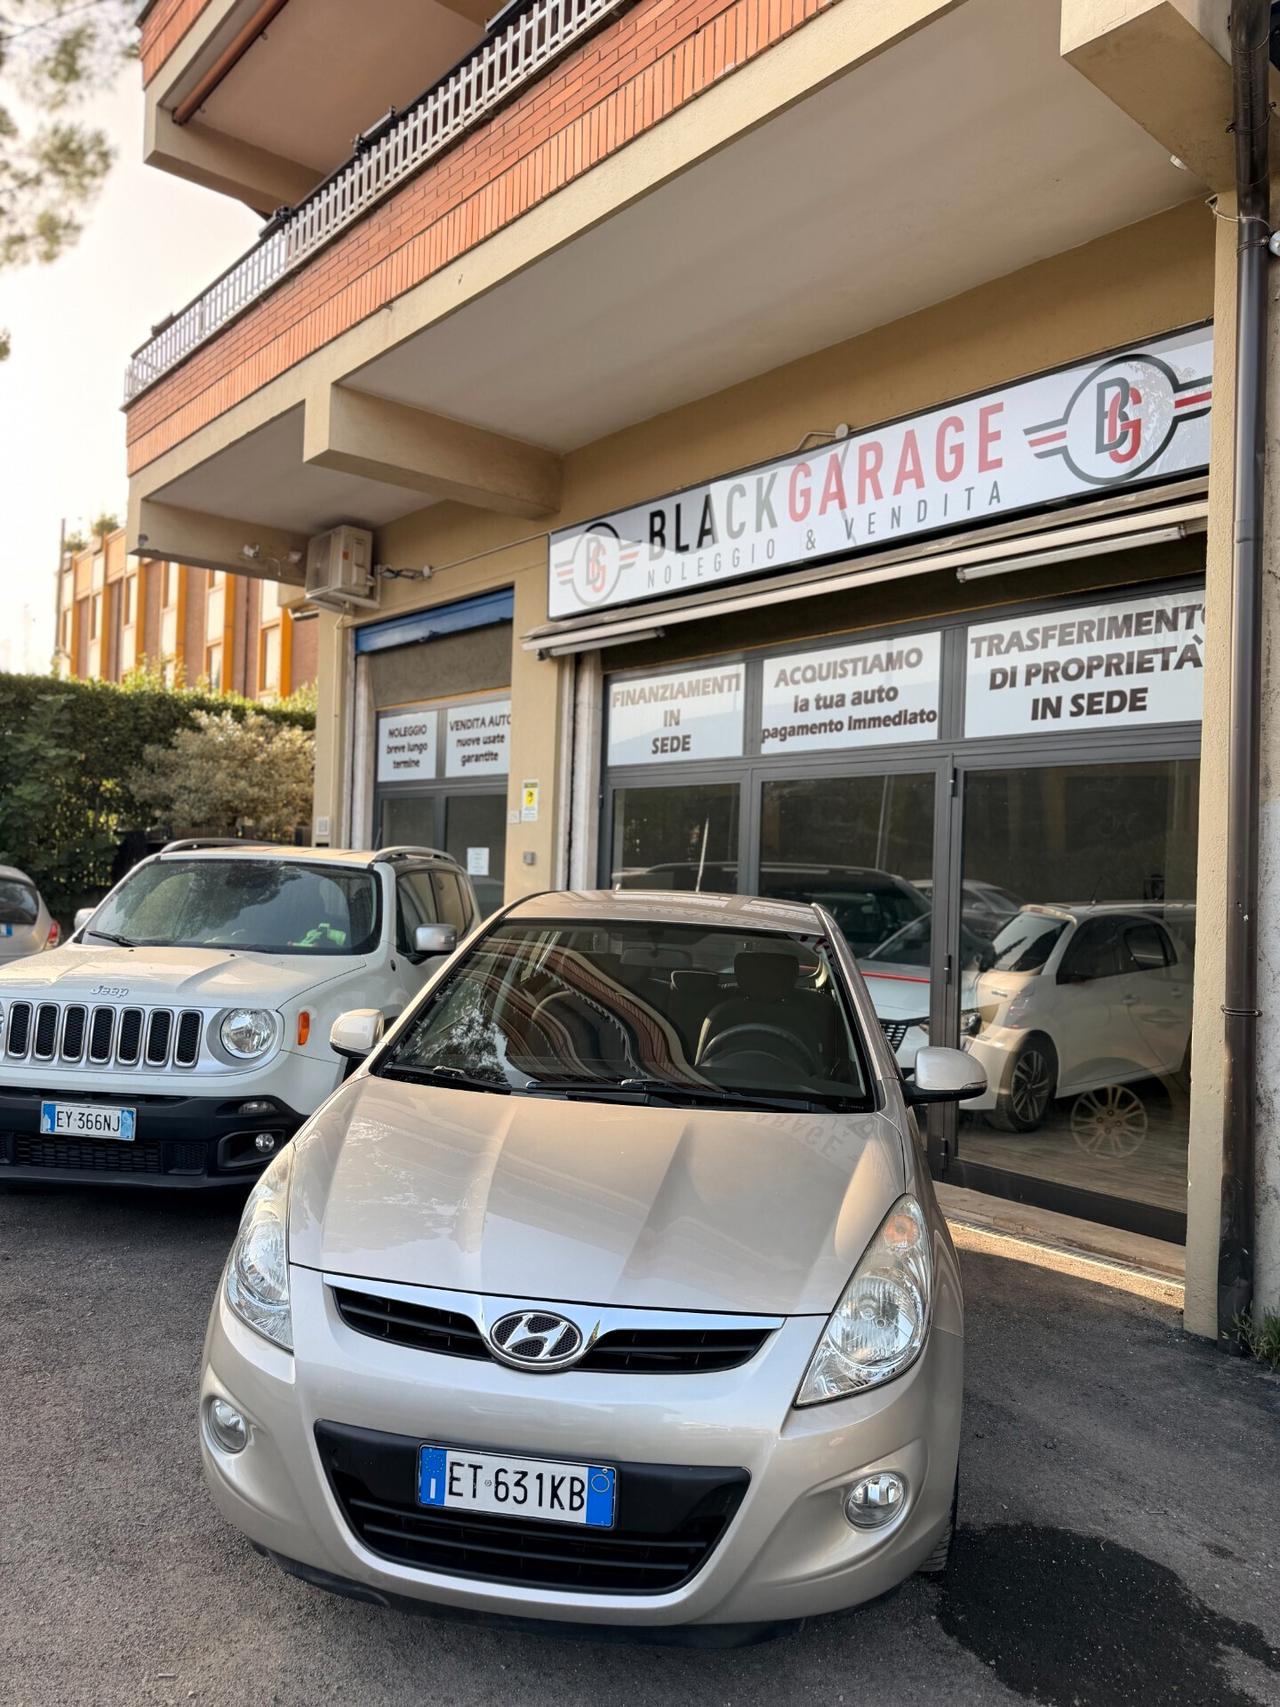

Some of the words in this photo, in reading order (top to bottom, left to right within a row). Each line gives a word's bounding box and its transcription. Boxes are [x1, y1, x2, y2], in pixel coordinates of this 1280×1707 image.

[648, 539, 775, 589] NOLEGGIO
[805, 529, 816, 551] &
[845, 480, 1001, 540] VENDITA
[970, 603, 1205, 659] TRASFERIMENT
[774, 647, 923, 688] ACQUISTIAMO
[989, 666, 1018, 690] DI
[1024, 634, 1203, 686] PROPRIETÀ
[612, 673, 741, 708] FINANZIAMENTI
[815, 693, 846, 711] tua
[851, 684, 899, 706] auto
[1031, 696, 1062, 721] IN
[1069, 687, 1148, 718] SEDE
[450, 717, 486, 731] VENDITA
[664, 709, 681, 727] IN
[761, 718, 844, 744] pagamento
[848, 708, 937, 731] immediato
[388, 724, 427, 738] NOLEGGIO
[456, 736, 480, 747] nuove
[483, 733, 505, 745] usate
[386, 744, 405, 754] breve
[407, 742, 428, 755] lungo
[652, 734, 691, 755] SEDE
[461, 750, 498, 767] garantite
[90, 985, 129, 998] Jeep
